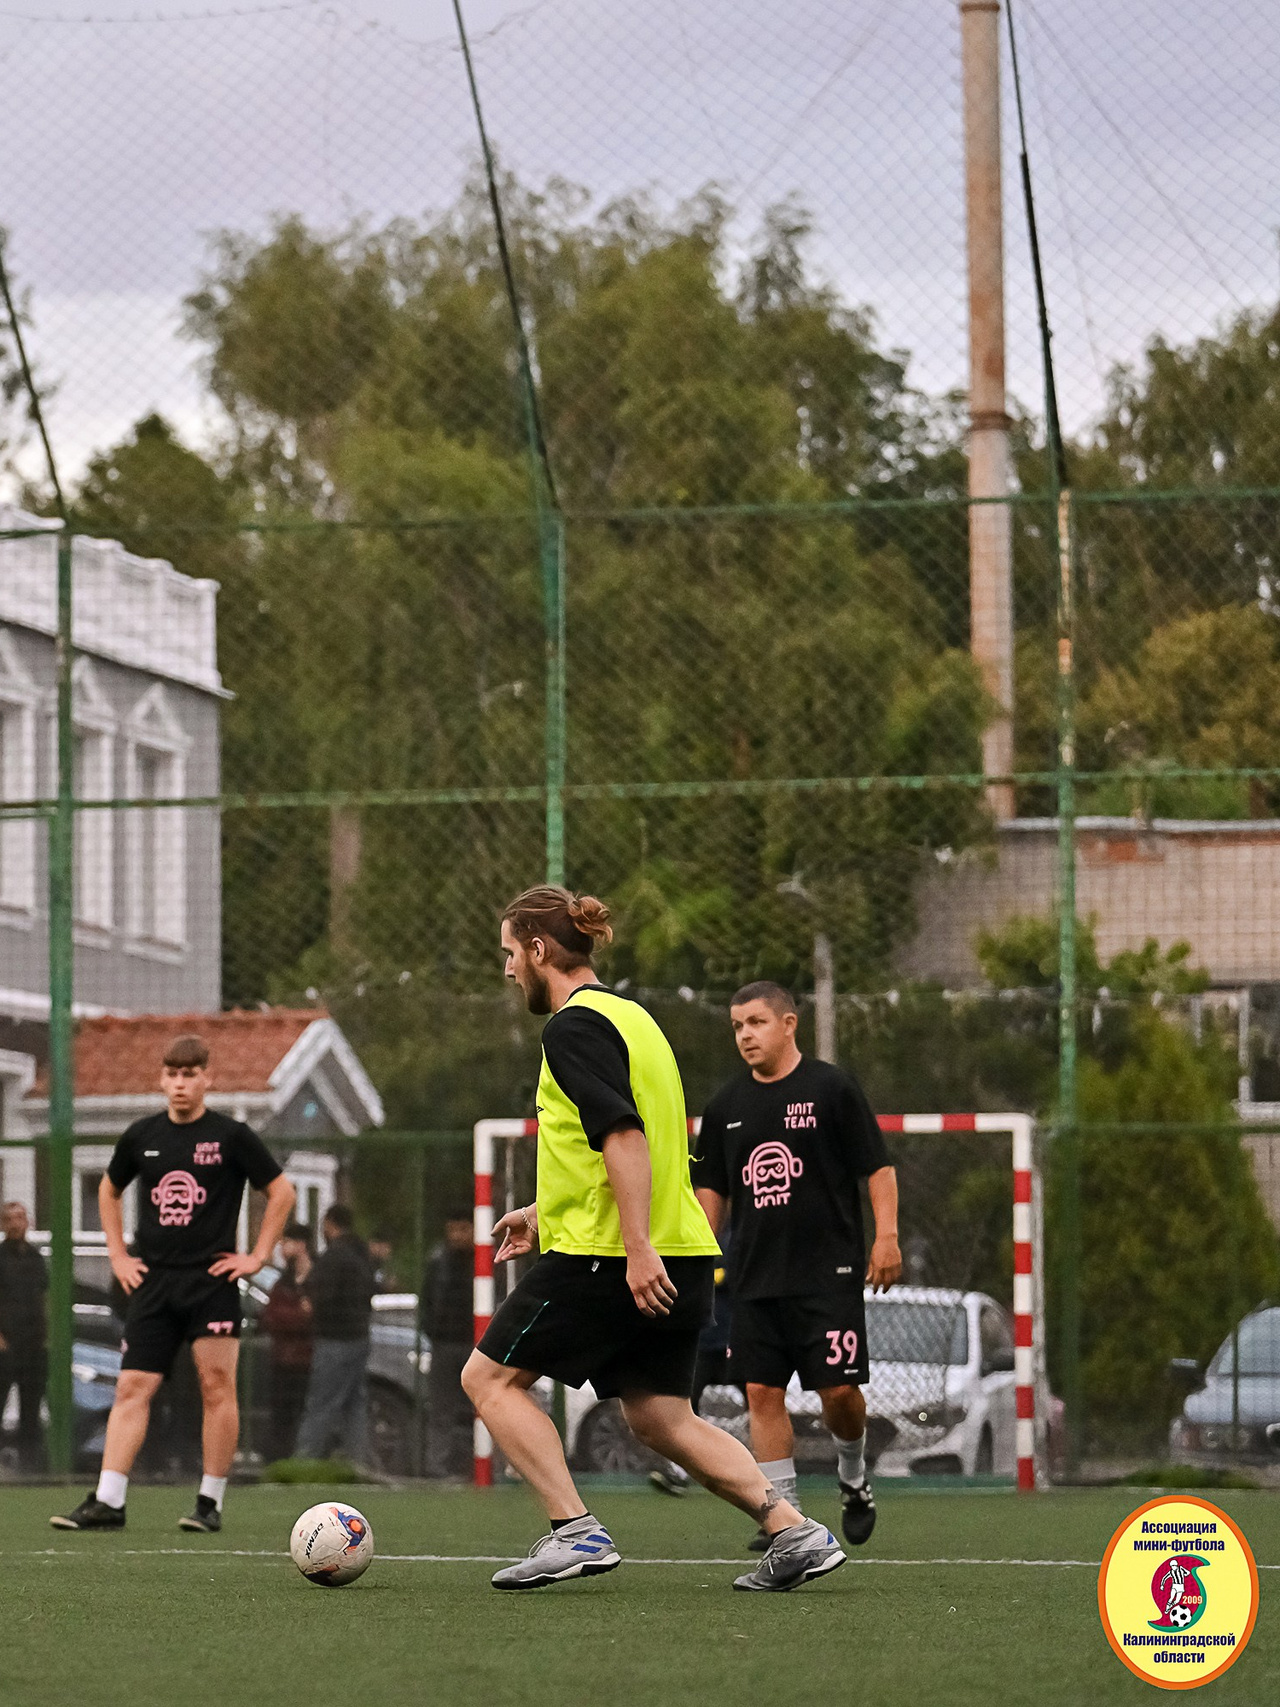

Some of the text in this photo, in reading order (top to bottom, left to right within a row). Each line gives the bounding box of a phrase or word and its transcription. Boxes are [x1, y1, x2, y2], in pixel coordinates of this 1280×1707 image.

[786, 1102, 815, 1116] UNIT
[783, 1115, 817, 1130] TEAM
[754, 1192, 792, 1209] UNIT
[825, 1330, 858, 1366] 39
[304, 1522, 324, 1560] DEMIX
